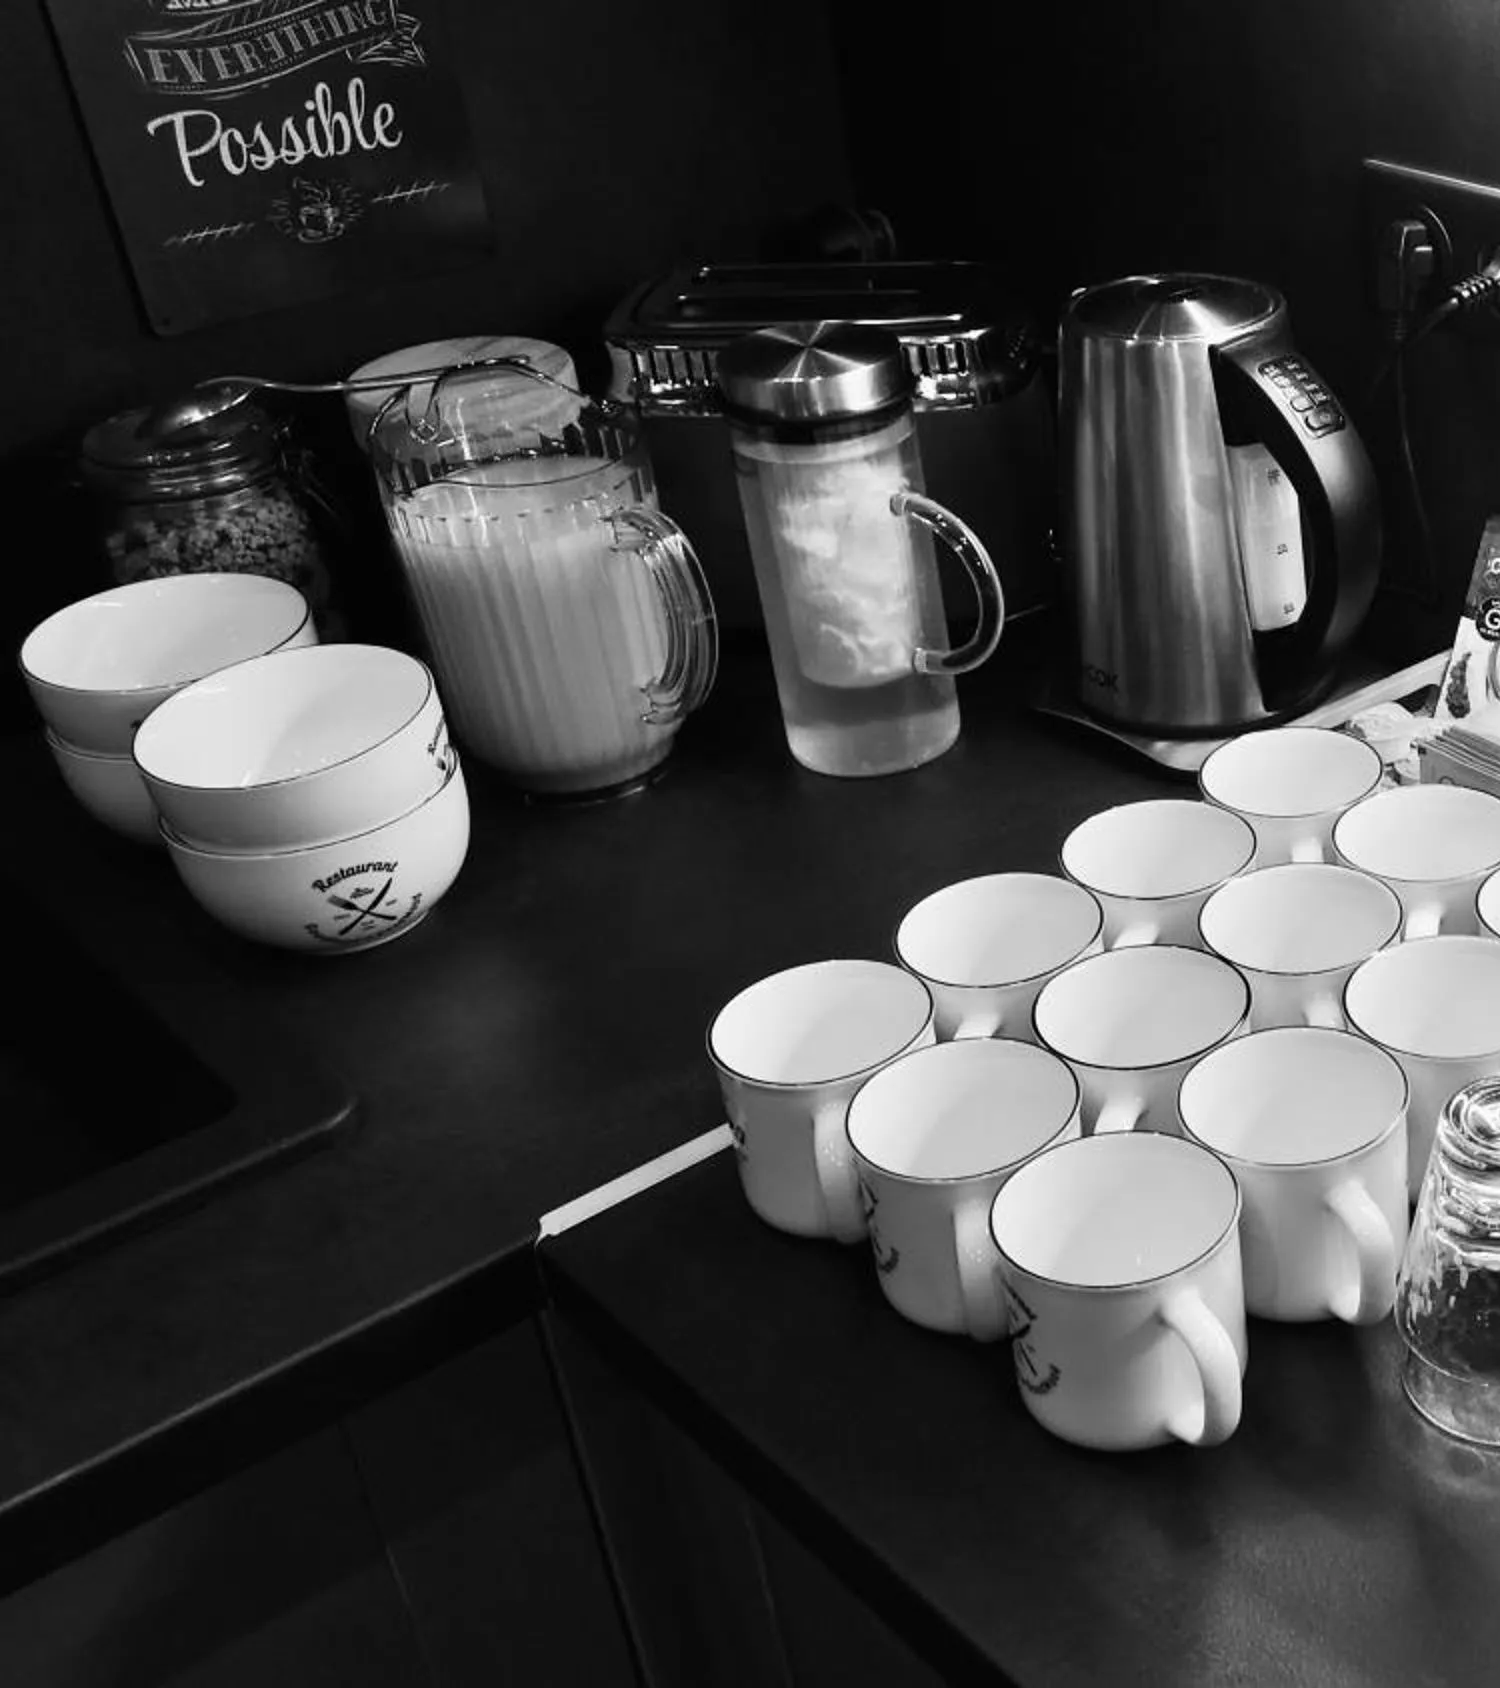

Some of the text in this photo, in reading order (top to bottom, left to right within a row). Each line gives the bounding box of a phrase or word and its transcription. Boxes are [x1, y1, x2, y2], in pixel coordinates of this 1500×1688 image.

[144, 0, 388, 84] EVERYTHING
[147, 77, 403, 187] Possible
[311, 861, 398, 893] Restaurant
